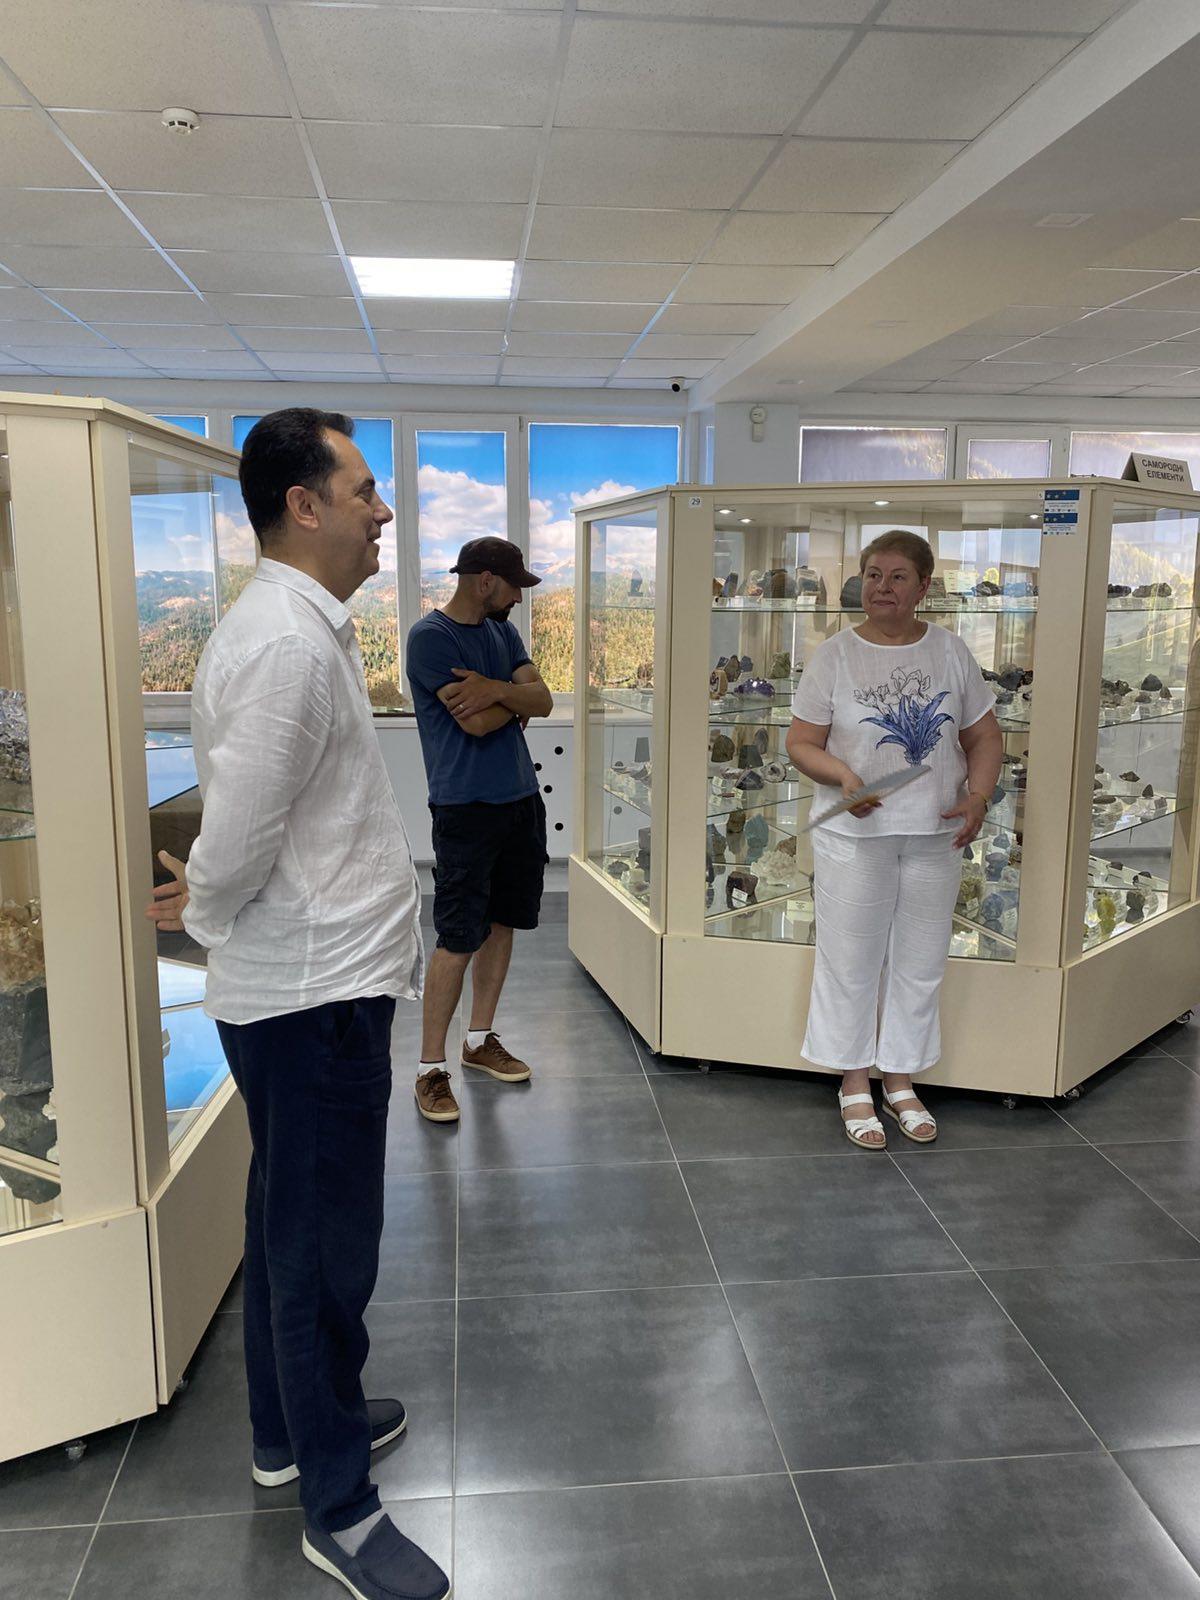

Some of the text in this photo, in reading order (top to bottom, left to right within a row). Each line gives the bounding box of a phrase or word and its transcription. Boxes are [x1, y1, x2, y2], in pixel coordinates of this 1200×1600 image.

[1141, 459, 1184, 472] САМОРОДНІ
[1147, 470, 1184, 482] ЕЛЕМЕНТИ
[691, 497, 700, 505] 29
